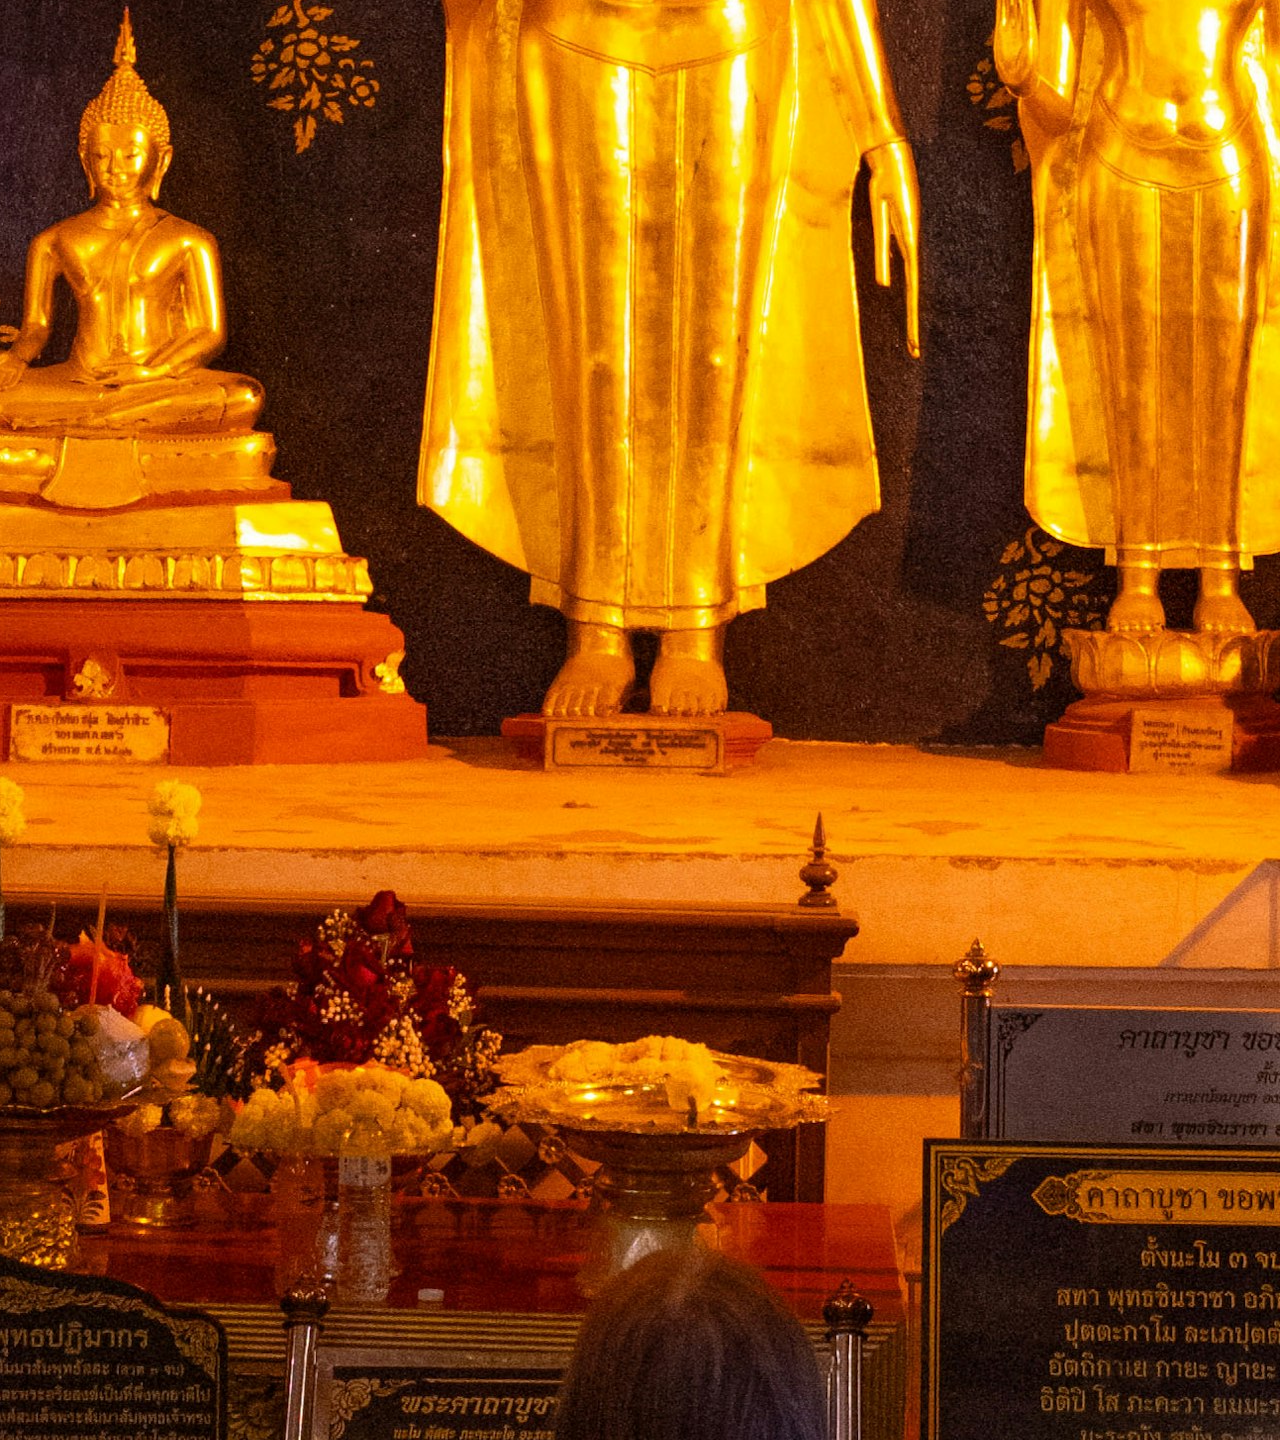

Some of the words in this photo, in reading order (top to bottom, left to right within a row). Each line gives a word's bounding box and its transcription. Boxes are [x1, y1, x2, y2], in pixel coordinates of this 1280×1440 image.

[1118, 1028, 1229, 1060] คาถาบูชา
[1085, 1183, 1207, 1219] คาถาบูชา
[1140, 1234, 1221, 1269] ตั้งนะโม
[1228, 1251, 1248, 1270] ๓
[1056, 1287, 1100, 1308] สทา
[1064, 1314, 1177, 1349] ปุตตะกาโม
[1155, 1360, 1209, 1379] กายะ
[1215, 1361, 1276, 1386] ญายะ
[1039, 1386, 1086, 1413] อิติปิ
[1092, 1384, 1120, 1413] โส
[1126, 1396, 1205, 1415] ภะคะวา
